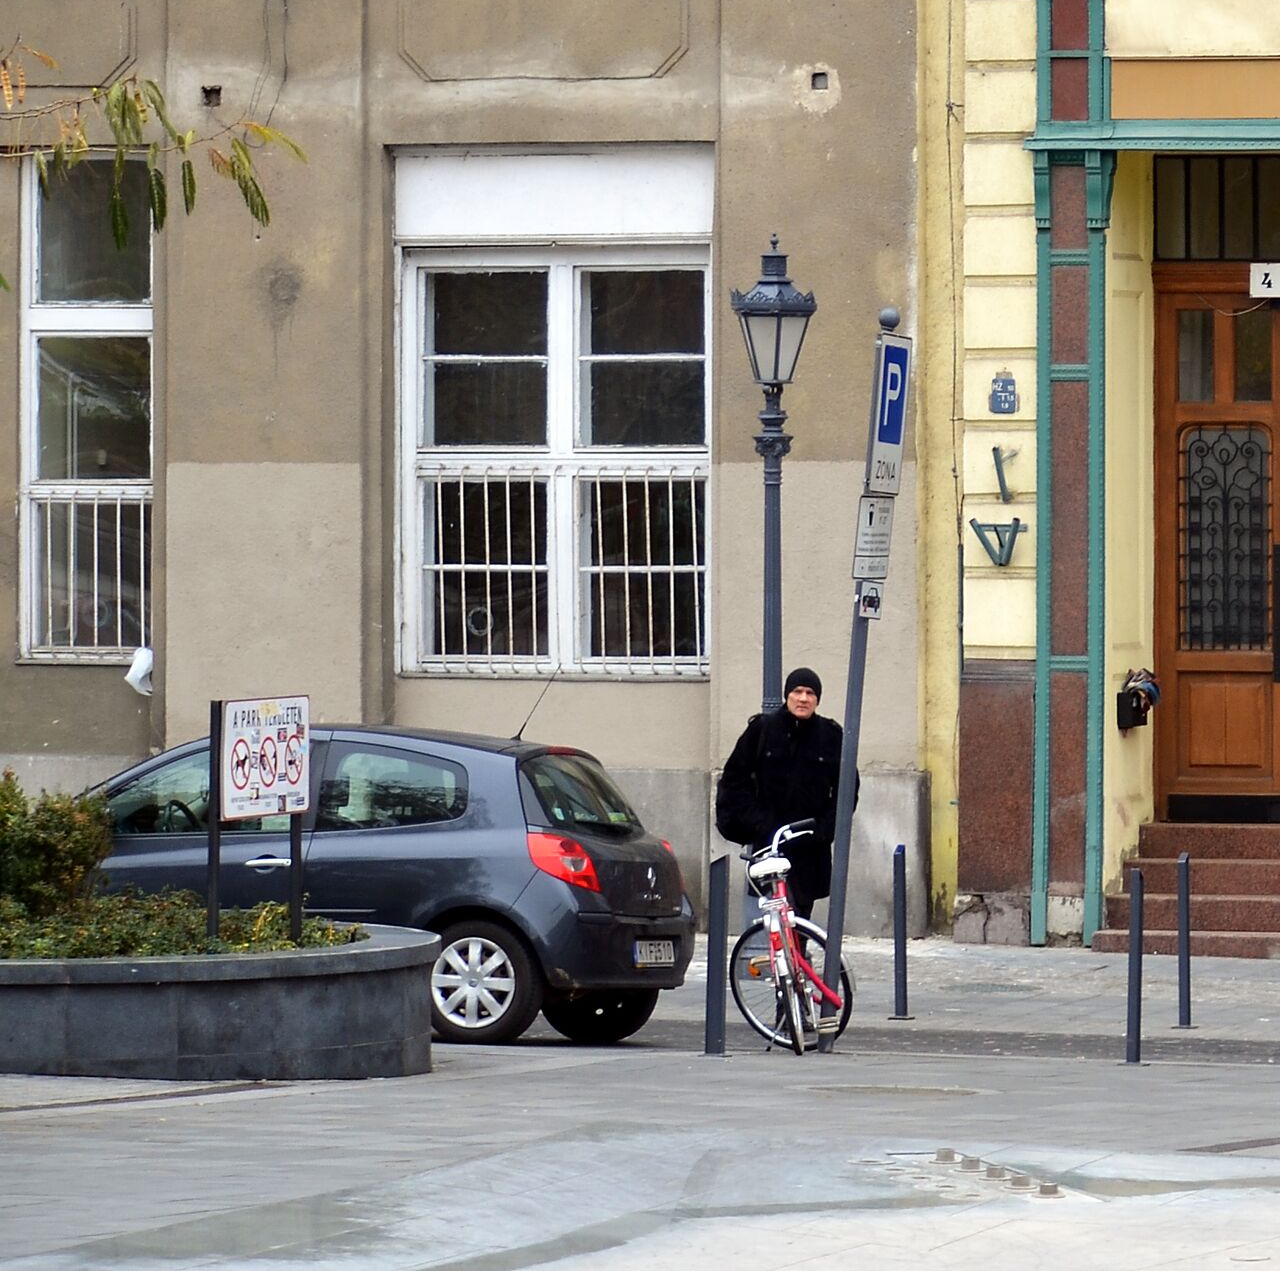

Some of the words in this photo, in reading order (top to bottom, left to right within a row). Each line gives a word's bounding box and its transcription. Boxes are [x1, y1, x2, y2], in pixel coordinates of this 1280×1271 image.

[1261, 272, 1273, 289] 4
[883, 362, 902, 426] P
[233, 710, 238, 728] A
